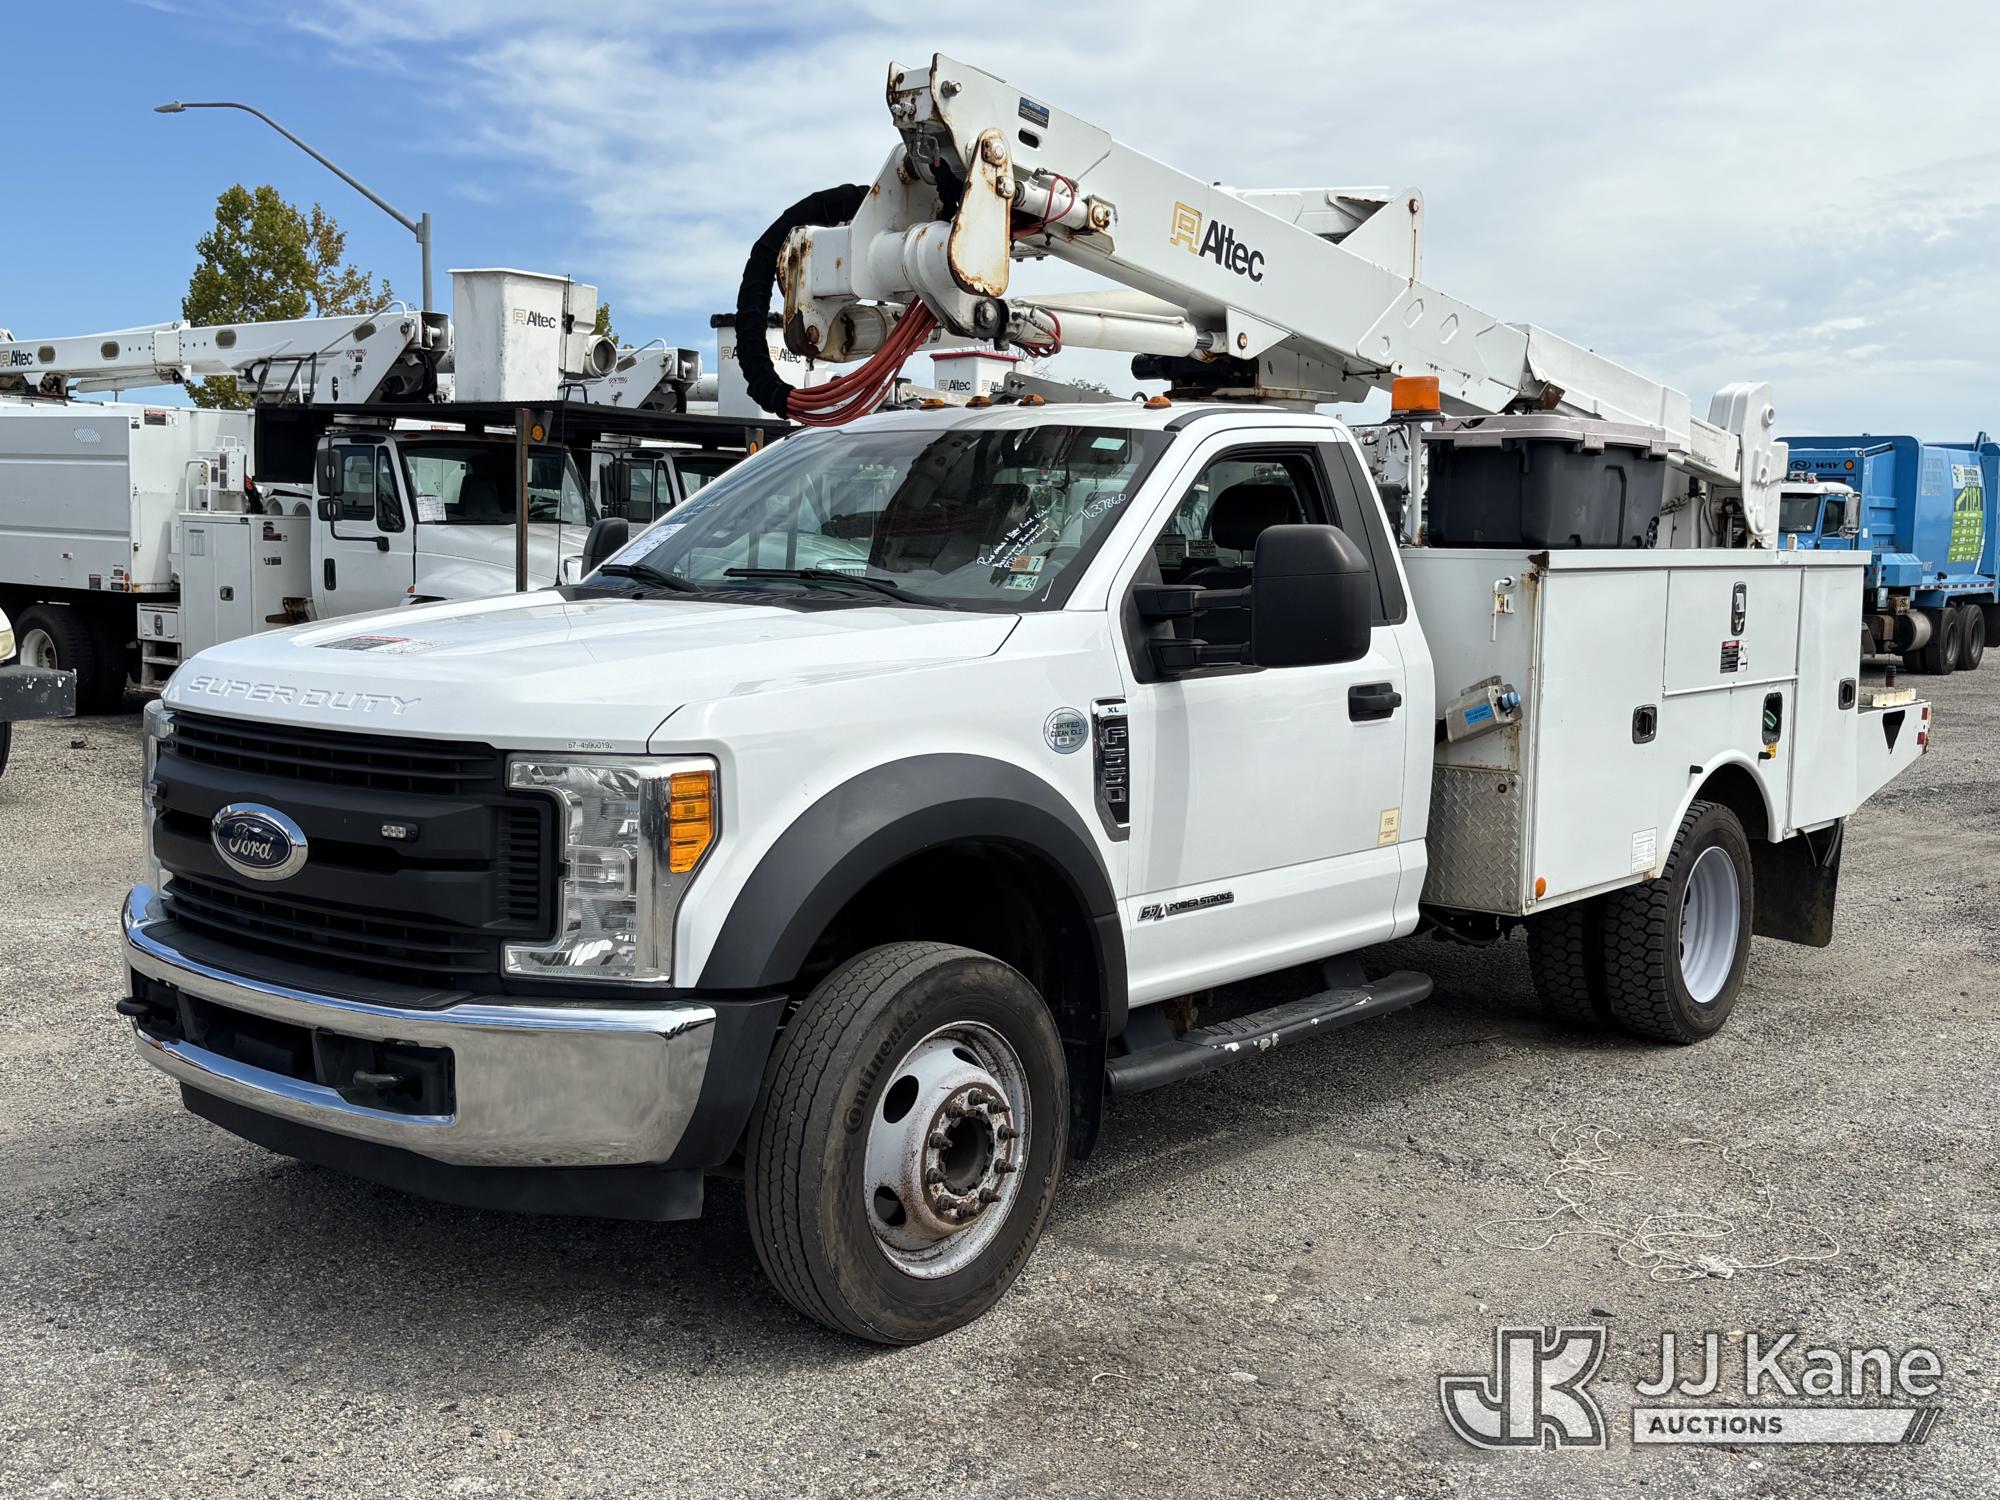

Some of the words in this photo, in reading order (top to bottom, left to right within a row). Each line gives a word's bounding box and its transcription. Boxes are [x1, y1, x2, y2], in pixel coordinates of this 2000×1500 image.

[1198, 219, 1264, 282] Altec
[526, 310, 556, 328] Altec
[10, 349, 33, 367] Altec
[779, 347, 801, 364] Altec
[948, 379, 971, 392] Altec
[1080, 493, 1127, 520] 1637860
[187, 675, 298, 704] SUPER
[299, 688, 422, 715] DUTY
[228, 822, 274, 860] Ford
[1168, 898, 1199, 912] POWER
[1199, 891, 1234, 906] STROKE
